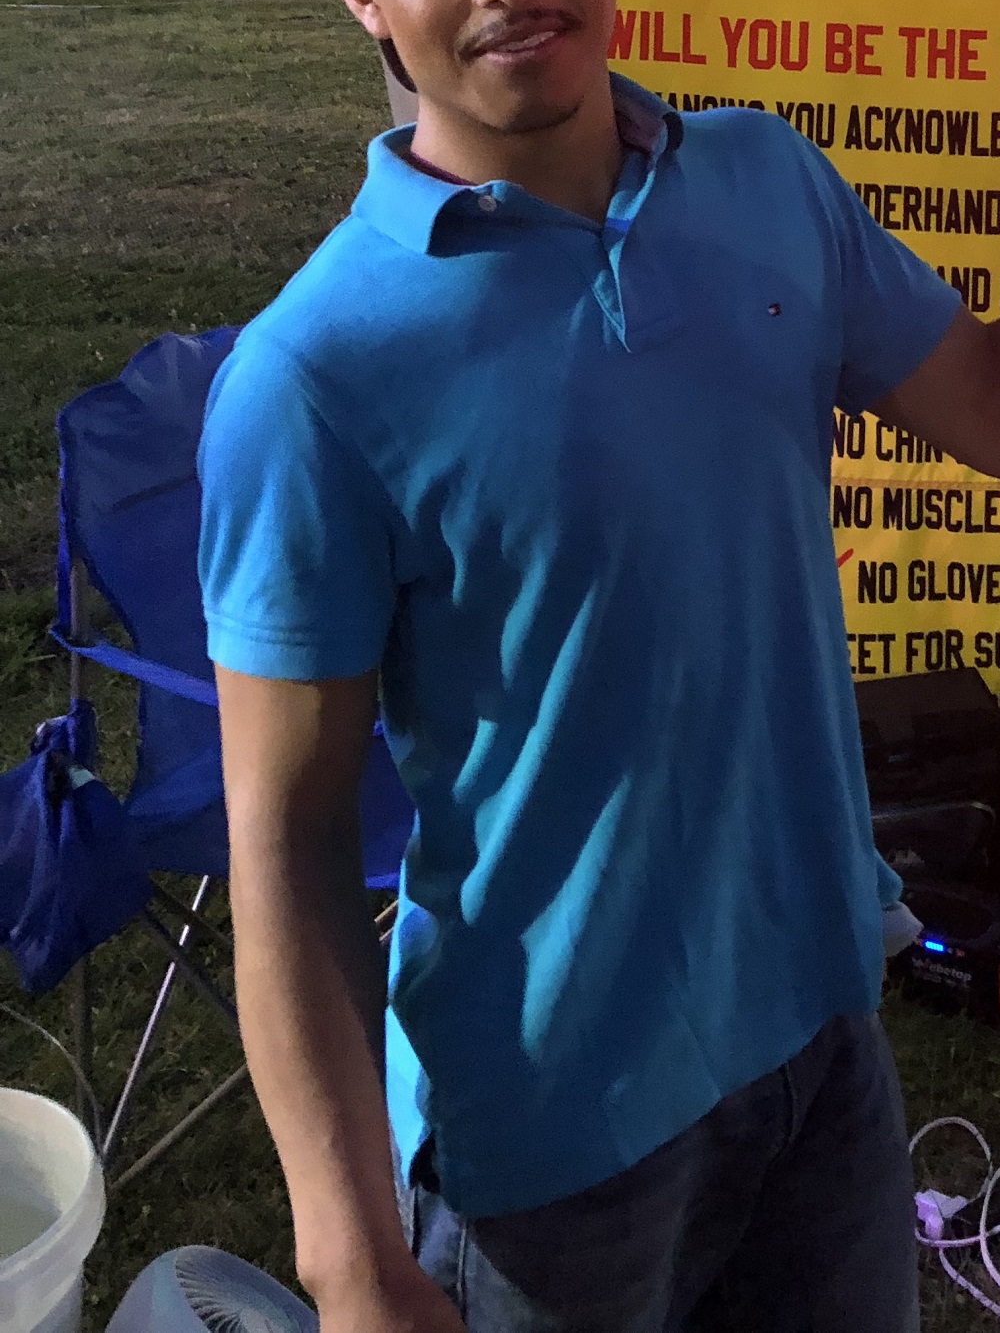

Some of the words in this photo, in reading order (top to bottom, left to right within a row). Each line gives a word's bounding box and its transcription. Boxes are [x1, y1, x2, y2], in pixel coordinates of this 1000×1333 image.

[720, 17, 809, 71] YOU
[826, 23, 883, 76] BE
[899, 27, 987, 80] THE
[775, 101, 836, 149] YOU
[832, 413, 866, 459] NO
[833, 486, 871, 529] NO
[858, 561, 897, 603] NO
[906, 629, 964, 672] FOR
